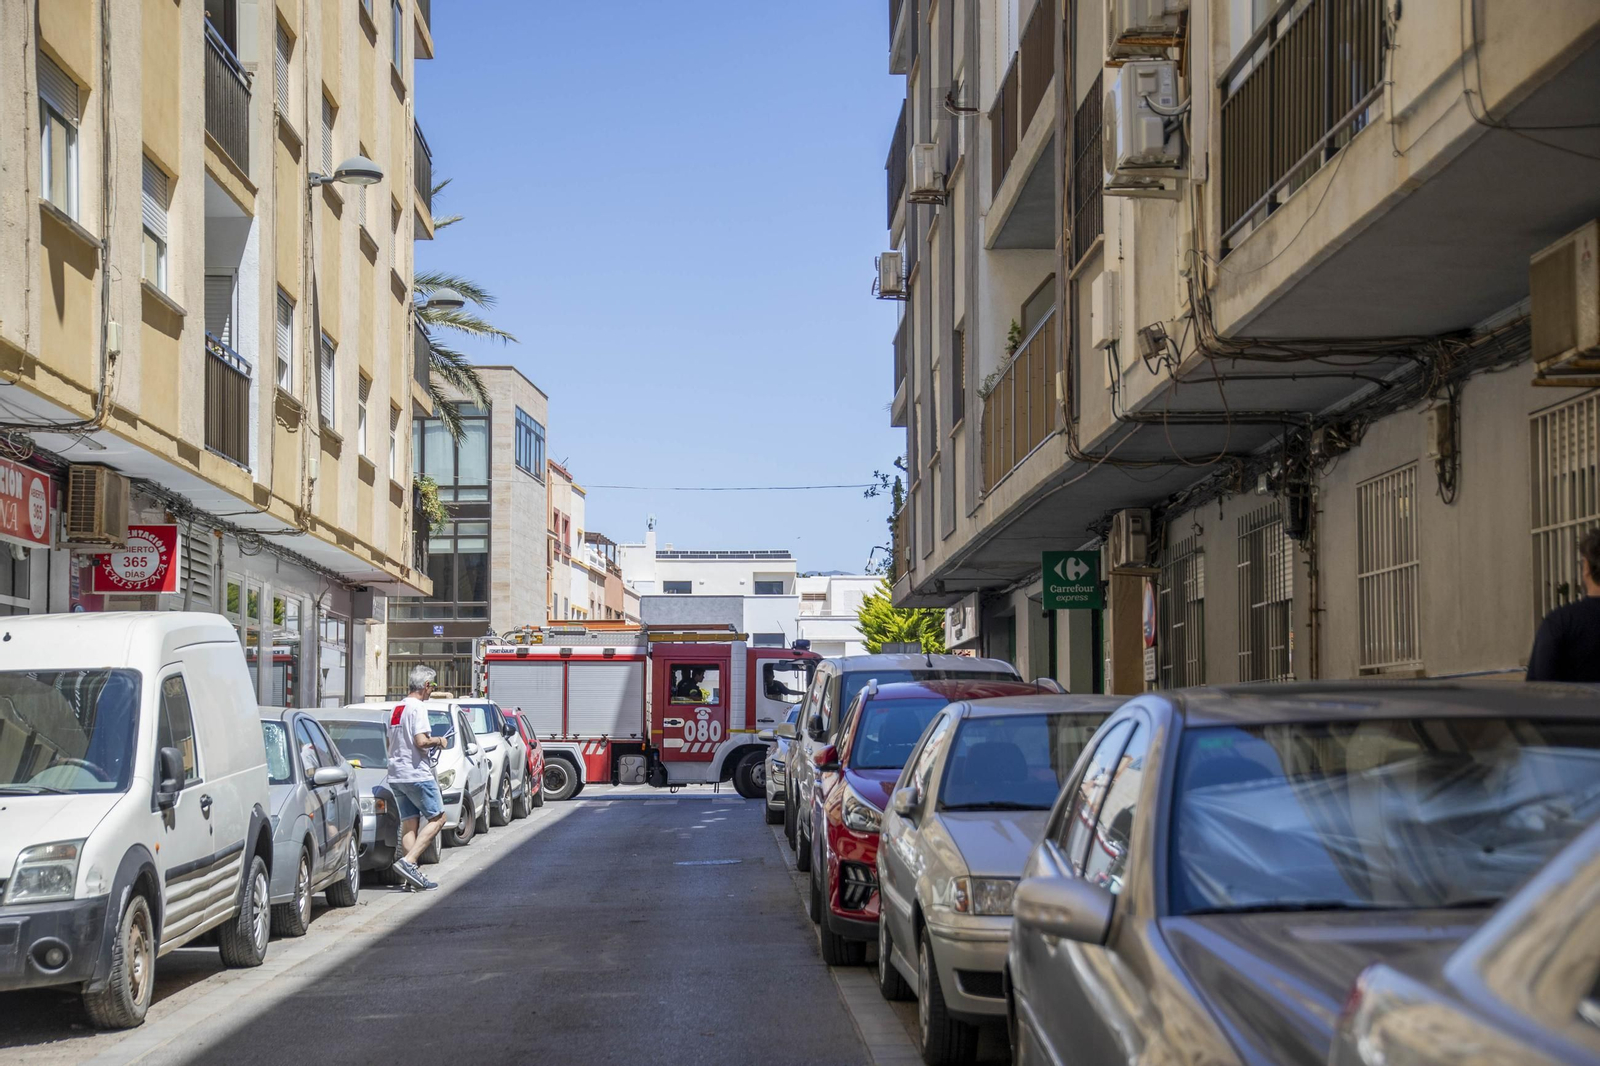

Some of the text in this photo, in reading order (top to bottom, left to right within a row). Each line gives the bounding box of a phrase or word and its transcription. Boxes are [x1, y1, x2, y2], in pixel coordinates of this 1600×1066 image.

[33, 503, 43, 521] 365
[123, 556, 148, 568] 365
[102, 563, 168, 589] KRISTINA
[125, 570, 146, 578] DÍAS
[1050, 584, 1094, 593] Carrefour
[684, 720, 722, 742] 080
